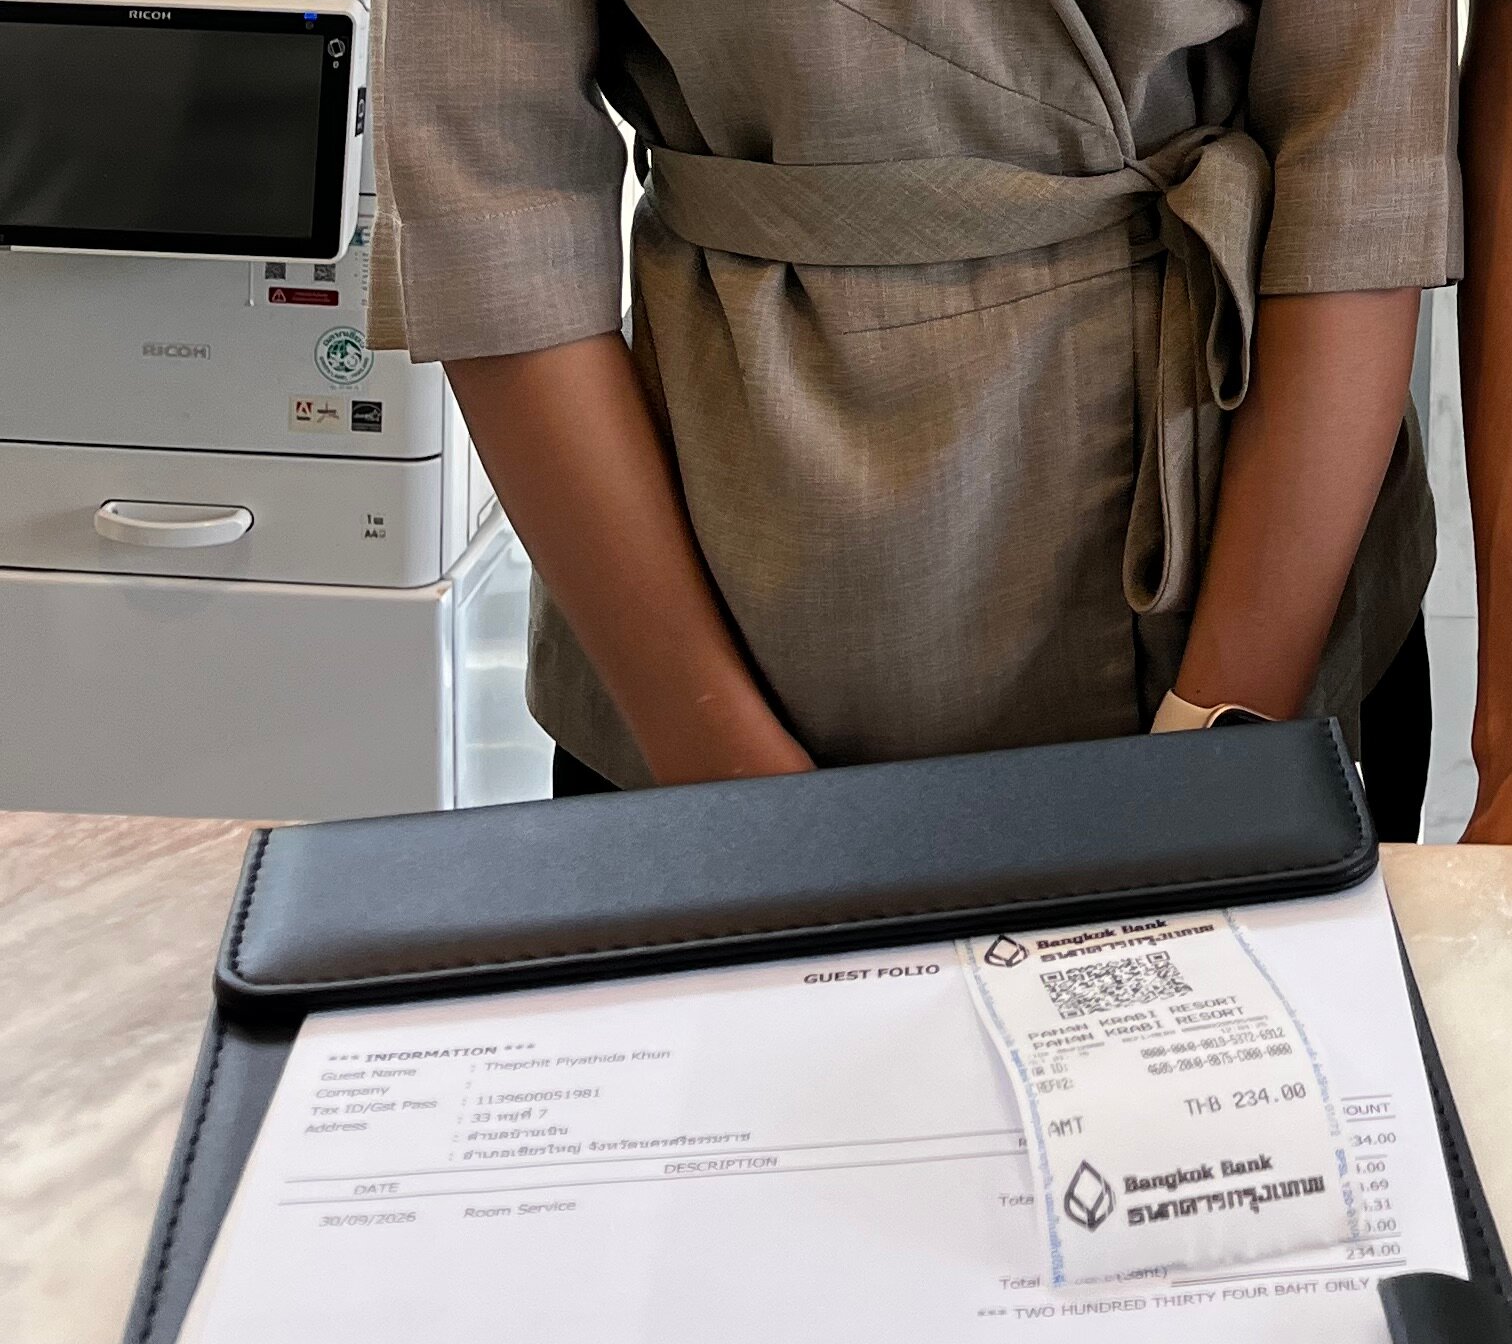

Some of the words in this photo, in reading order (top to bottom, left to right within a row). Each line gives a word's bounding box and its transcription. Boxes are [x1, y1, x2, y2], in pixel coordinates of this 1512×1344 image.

[128, 9, 171, 20] RICOH
[142, 344, 207, 358] RICOH
[1035, 928, 1118, 950] Bangkok
[1122, 919, 1168, 935] Bank
[803, 969, 871, 984] GUEST
[877, 964, 940, 978] FOLIO
[1099, 1010, 1158, 1027] KRABI
[1169, 996, 1238, 1014] RESORT
[1105, 1020, 1164, 1037] KRABI
[1175, 1007, 1245, 1025] RESORT
[365, 1045, 497, 1062] INFORMATION
[320, 1069, 365, 1081] Guest
[371, 1067, 417, 1078] Name
[484, 1059, 551, 1072] Thepchit
[631, 1049, 672, 1060] Khun
[315, 1085, 390, 1099] Company
[1184, 1096, 1221, 1116] THB
[1232, 1082, 1306, 1109] 234.00
[311, 1105, 339, 1116] Tax
[402, 1099, 438, 1110] Pass
[304, 1121, 369, 1133] Address
[470, 1112, 490, 1123] 33
[537, 1109, 548, 1119] 7
[1048, 1116, 1084, 1137] AMT
[1351, 1132, 1396, 1147] 34.00
[664, 1156, 778, 1174] DESCRIPTION
[1123, 1164, 1214, 1194] Bangkok
[1221, 1153, 1273, 1177] Bank
[353, 1183, 399, 1196] DATE
[464, 1205, 511, 1218] Room
[517, 1200, 577, 1216] Service
[1000, 1195, 1035, 1207] Tota
[1127, 1176, 1326, 1227] ธนาคารกรุงเทพ
[1000, 1277, 1041, 1290] Total
[1346, 1243, 1401, 1260] 234.00
[1014, 1305, 1055, 1320] TWO
[1061, 1298, 1147, 1317] HUNDRED
[1155, 1291, 1216, 1308] THIRTY
[1222, 1286, 1268, 1301] FOUR
[1275, 1281, 1320, 1297] BAHT
[1325, 1277, 1370, 1293] ONLY
